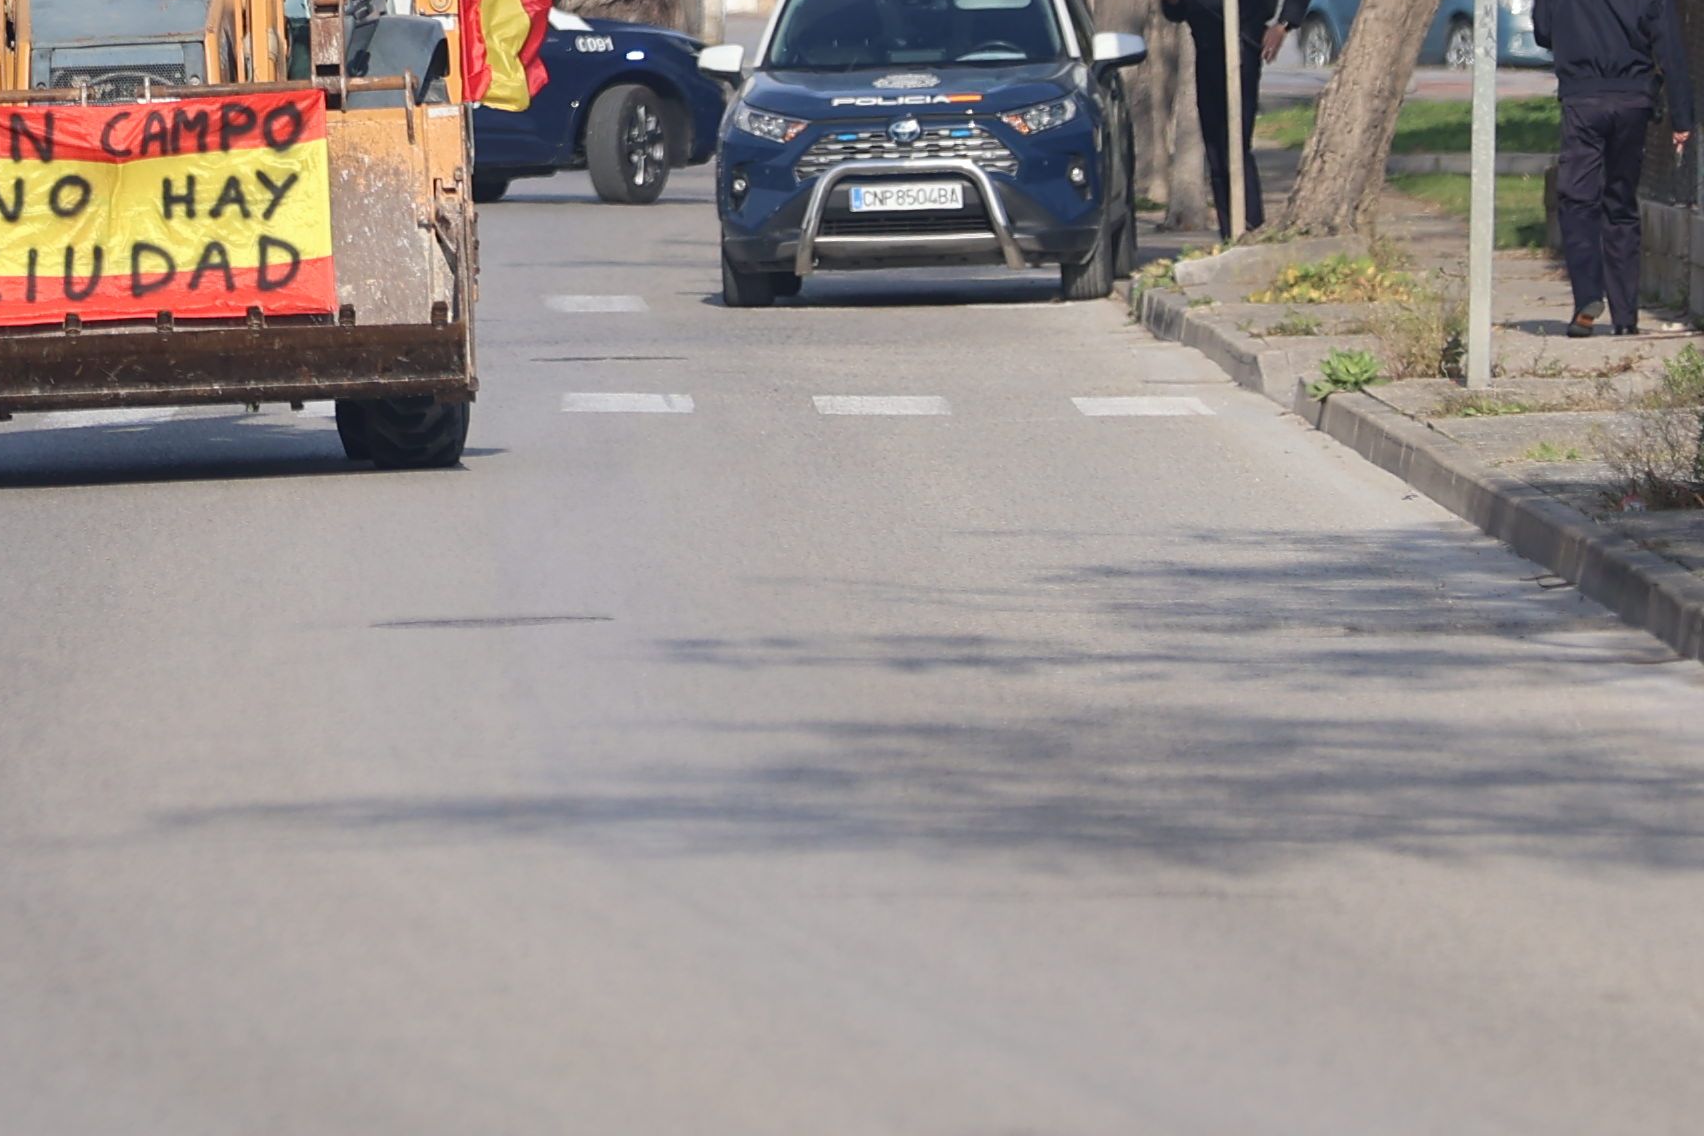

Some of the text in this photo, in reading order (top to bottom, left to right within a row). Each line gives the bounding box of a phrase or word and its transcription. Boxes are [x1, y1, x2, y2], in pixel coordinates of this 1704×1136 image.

[831, 95, 951, 107] POLICIA
[100, 101, 304, 157] CAMPO
[162, 169, 298, 220] HAY
